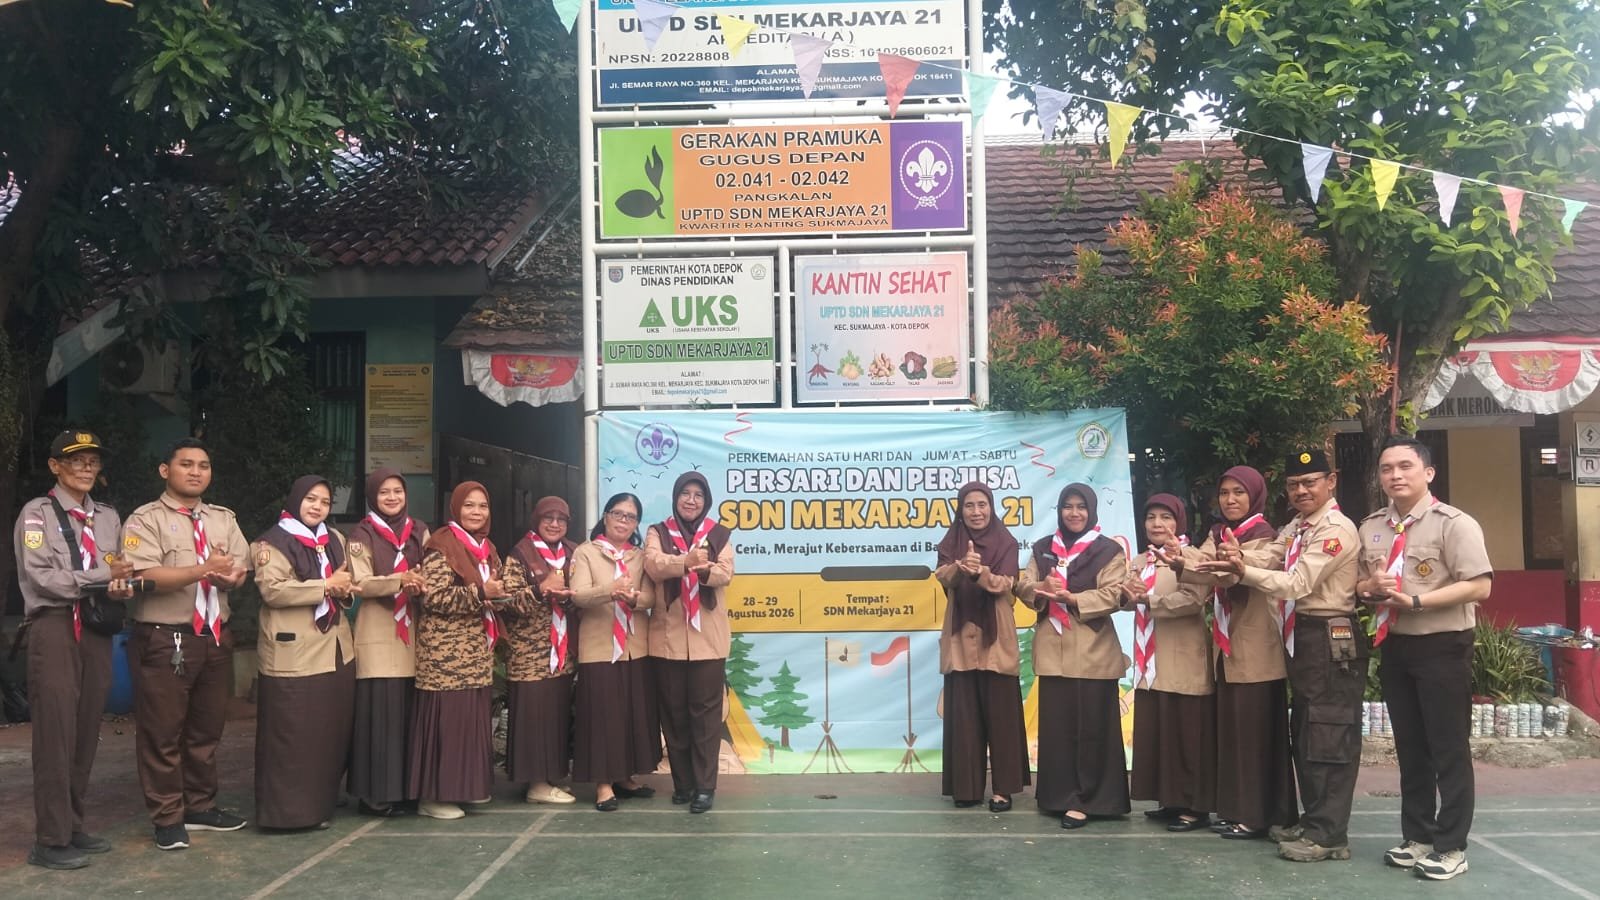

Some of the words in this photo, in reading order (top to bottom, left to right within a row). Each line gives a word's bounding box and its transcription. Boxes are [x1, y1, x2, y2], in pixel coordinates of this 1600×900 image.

[619, 16, 685, 33] UD
[754, 10, 907, 29] MEKARJAYA
[915, 9, 941, 25] 21
[608, 54, 656, 65] NPSN:
[661, 51, 730, 64] 20228808
[621, 81, 654, 89] SEMAR
[655, 80, 679, 88] RAYA
[713, 79, 733, 87] KEL.
[735, 77, 789, 86] MEKARJAYA
[816, 76, 869, 84] UKMAJAYA
[679, 132, 777, 152] GERAKAN
[783, 129, 882, 149] PRAMUKA
[699, 152, 781, 167] GUGUS
[789, 150, 865, 164] DEPAN
[714, 170, 773, 189] 02.041
[790, 170, 850, 187] 02.042
[733, 191, 833, 203] PANGKALAN
[680, 206, 724, 222] UPTD
[728, 206, 762, 220] SDN
[766, 204, 867, 220] MEKARJAYA
[871, 203, 887, 217] 21
[679, 221, 741, 231] KWARTIR
[744, 219, 803, 230] RANTING
[807, 217, 889, 228] SUKMAJAYA
[630, 264, 687, 276] PEMERINTAH
[687, 263, 711, 274] KOTA
[714, 263, 743, 274] DEPOK
[640, 276, 671, 287] DINAS
[673, 275, 734, 287] PENDIDIKAN
[811, 271, 882, 296] KANTIN
[888, 270, 952, 295] SEHAT
[671, 294, 739, 327] UKS
[819, 305, 847, 319] UPTD
[848, 305, 870, 319] SDN
[871, 304, 932, 318] MEKARJAYA
[933, 303, 945, 317] 21
[834, 323, 849, 331] KEC.
[849, 322, 887, 331] SUKMAJAYA
[890, 322, 907, 330] KOTA
[908, 322, 930, 330] DEPOK
[609, 344, 643, 360] UPTD
[647, 343, 673, 359] SDN
[677, 342, 753, 358] MEKARJAYA
[756, 341, 769, 356] 21
[743, 378, 758, 386] DEPOK
[728, 452, 814, 464] PERKEMAHAN
[817, 451, 851, 463] SATU
[853, 451, 883, 462] HARI
[886, 450, 912, 462] DAN
[922, 449, 969, 461] JUM'AT
[979, 449, 1017, 461] SABTU
[726, 467, 842, 493] PERSARI
[845, 466, 902, 493] DAN
[906, 465, 1020, 492] PERJUSA
[718, 498, 785, 531] SDN
[1000, 496, 1034, 527] 21
[735, 543, 771, 556] Ceria,
[773, 542, 823, 557] Merajut
[825, 540, 908, 554] Kebersamaan
[910, 541, 922, 553] di
[743, 596, 755, 606] 28
[765, 595, 778, 606] 29
[846, 593, 884, 606] Tempat
[727, 608, 767, 620] Agustus
[768, 607, 795, 618] 2026
[823, 606, 846, 616] SDN
[846, 605, 901, 617] Mekarjaya
[903, 605, 914, 616] 21
